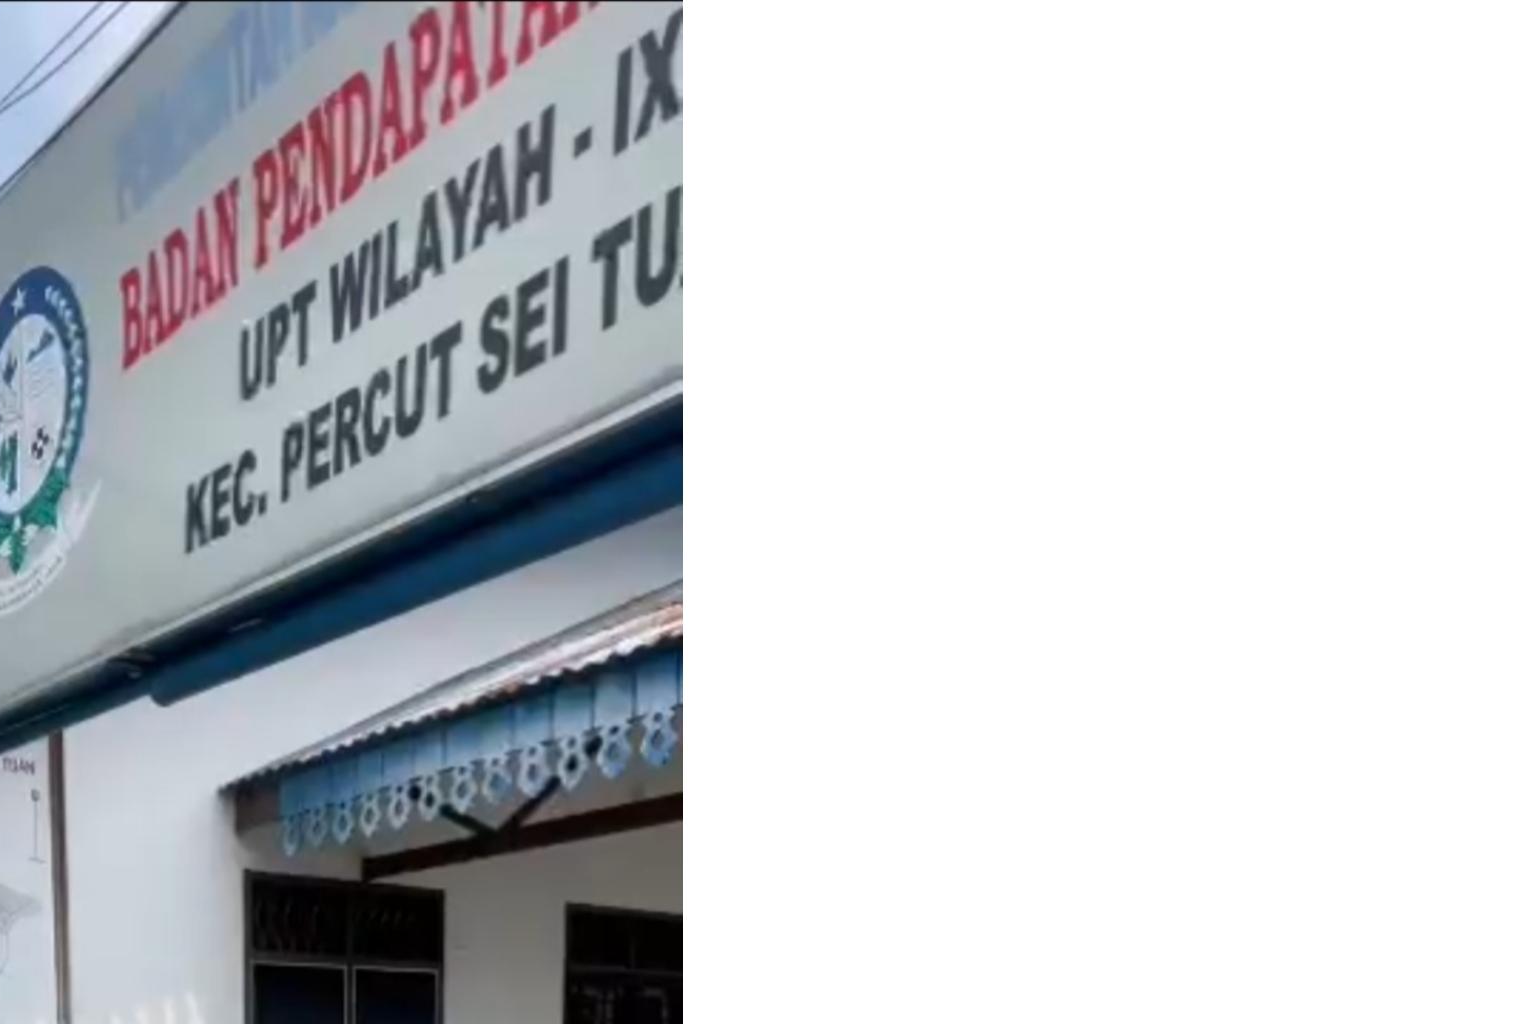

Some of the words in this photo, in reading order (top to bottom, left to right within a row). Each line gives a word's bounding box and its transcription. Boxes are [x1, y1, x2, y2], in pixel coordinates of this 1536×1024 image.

[120, 177, 239, 370] BADAN
[252, 0, 600, 269] PENDAPATA
[184, 449, 268, 554] KEC.
[280, 319, 462, 503] PERCUT
[476, 255, 570, 394] SEI
[590, 185, 683, 332] TU
[239, 280, 316, 401] UPT
[330, 104, 556, 344] WILAYAH
[613, 8, 683, 157] IX
